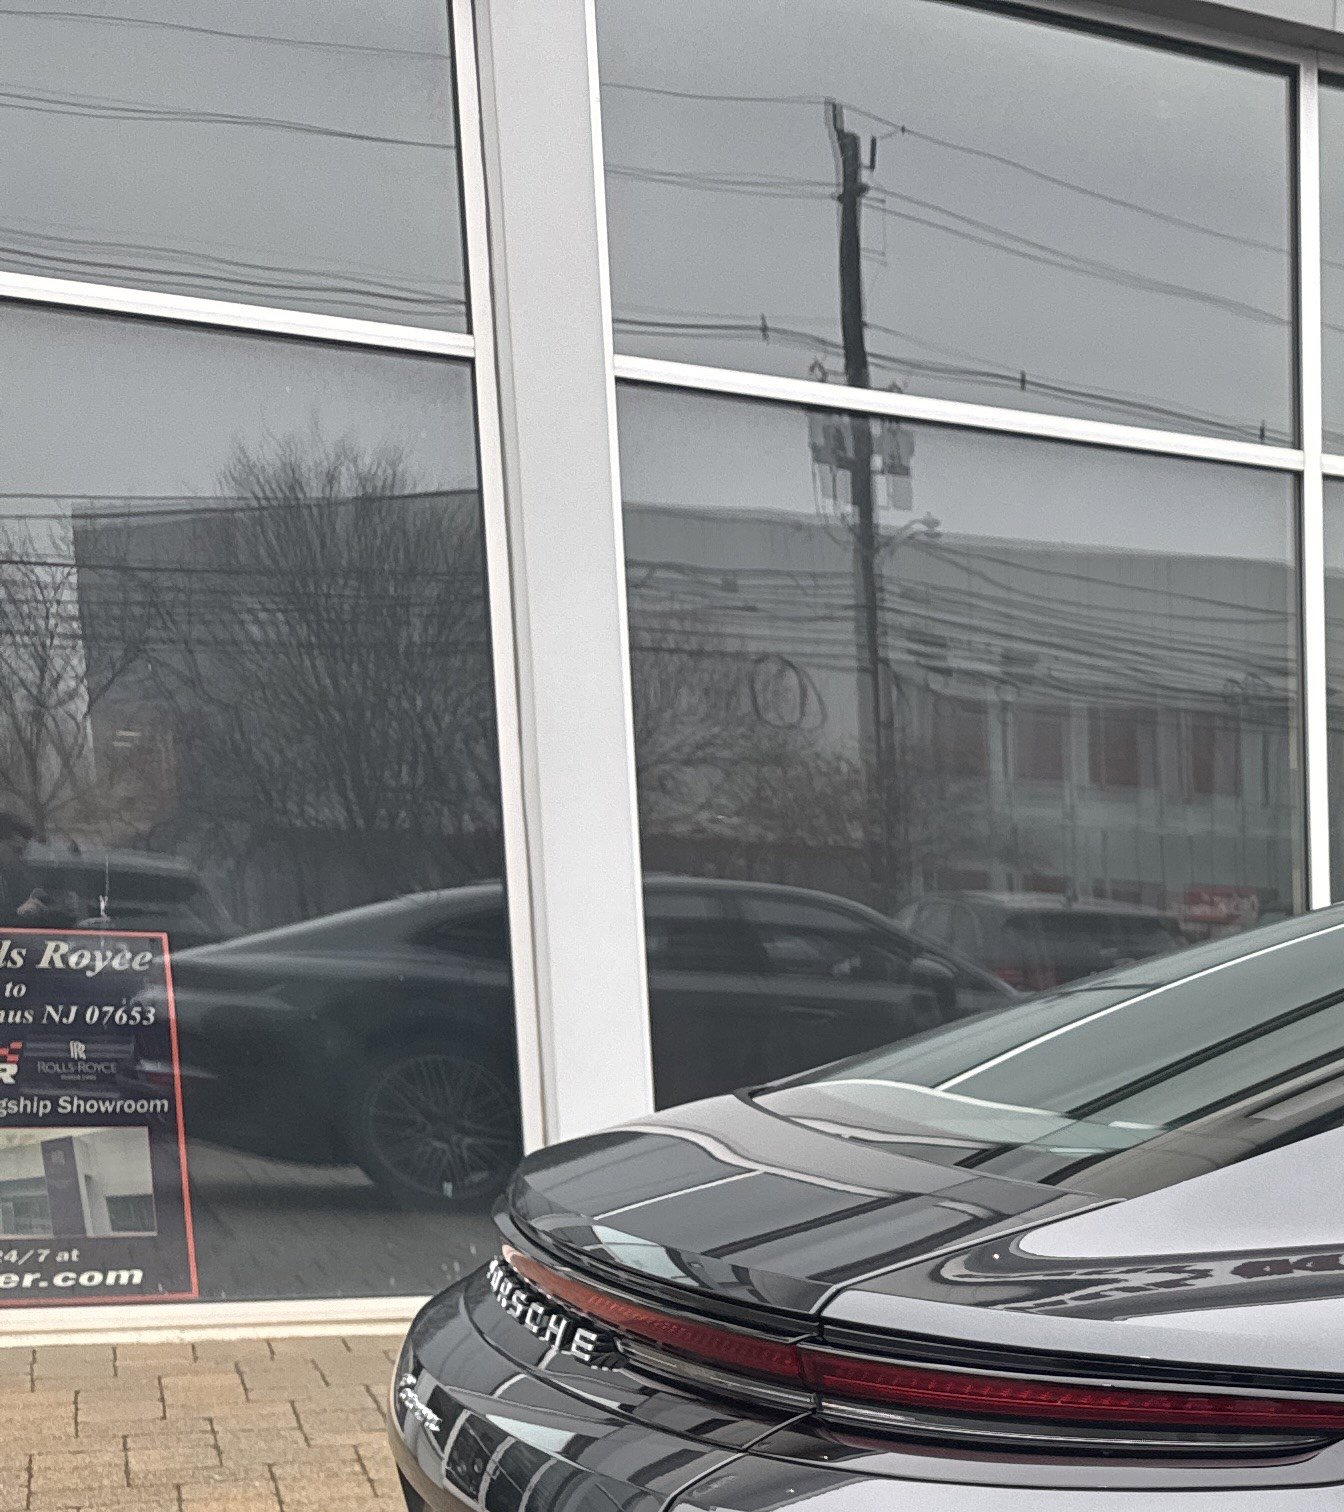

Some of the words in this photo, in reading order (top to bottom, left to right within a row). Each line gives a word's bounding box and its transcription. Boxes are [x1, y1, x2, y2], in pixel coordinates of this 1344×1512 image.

[36, 940, 153, 977] Royce
[5, 982, 27, 998] to
[42, 1005, 78, 1025] NJ
[86, 1005, 156, 1026] 07653
[57, 1096, 169, 1115] Showroom
[55, 1249, 81, 1263] at
